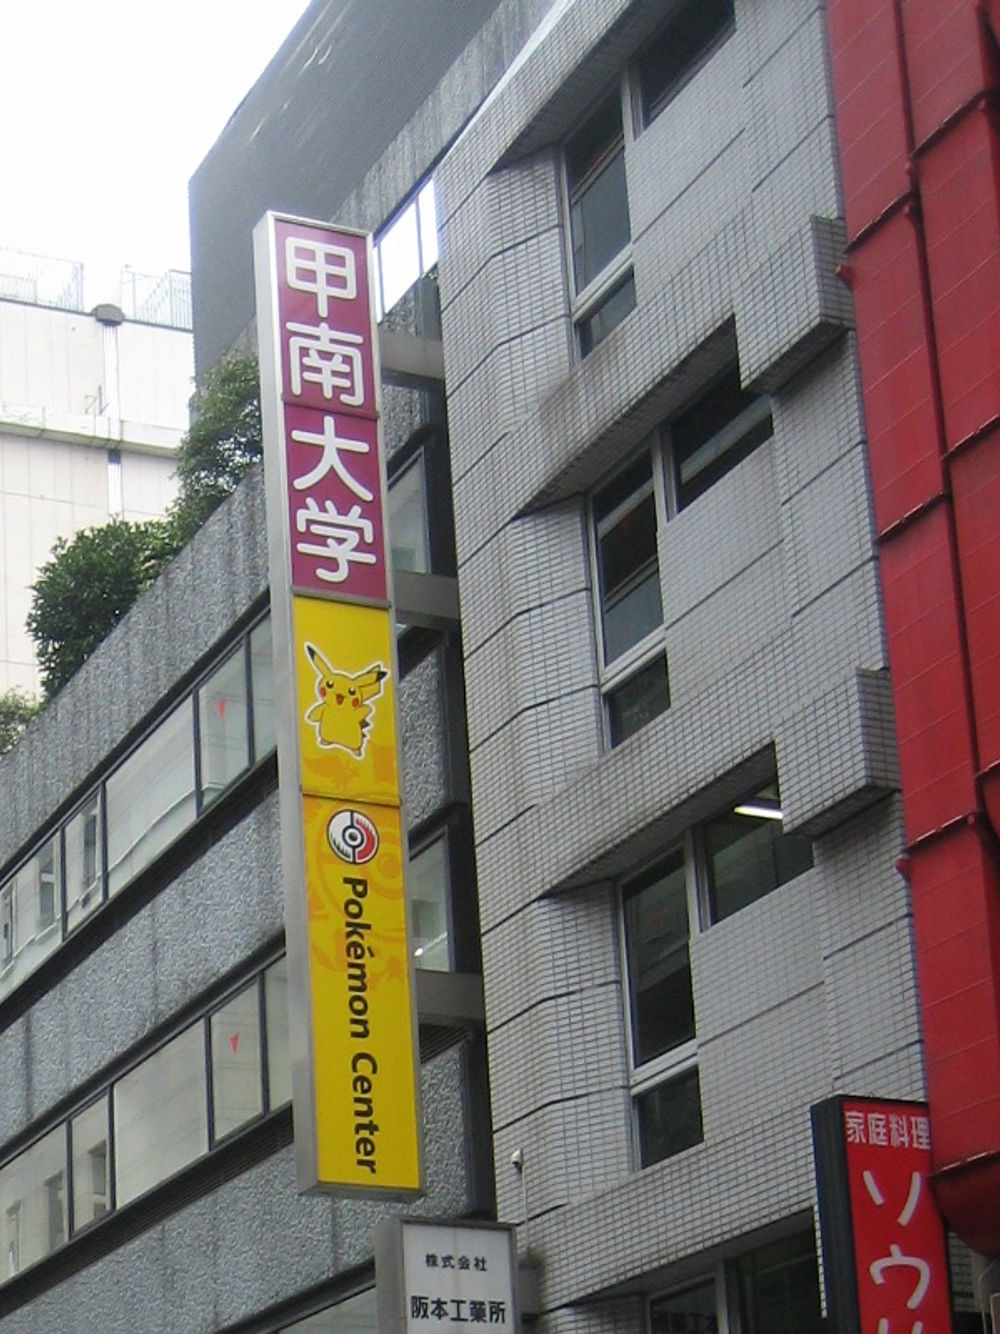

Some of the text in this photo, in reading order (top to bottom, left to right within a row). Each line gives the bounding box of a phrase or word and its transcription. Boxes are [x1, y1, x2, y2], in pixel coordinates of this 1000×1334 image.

[284, 236, 376, 584] 甲南大学
[343, 876, 380, 1175] Pokémon Center
[845, 1111, 931, 1150] 家庭料理
[425, 1253, 487, 1272] 株式会社
[411, 1295, 505, 1324] 阪本工業所
